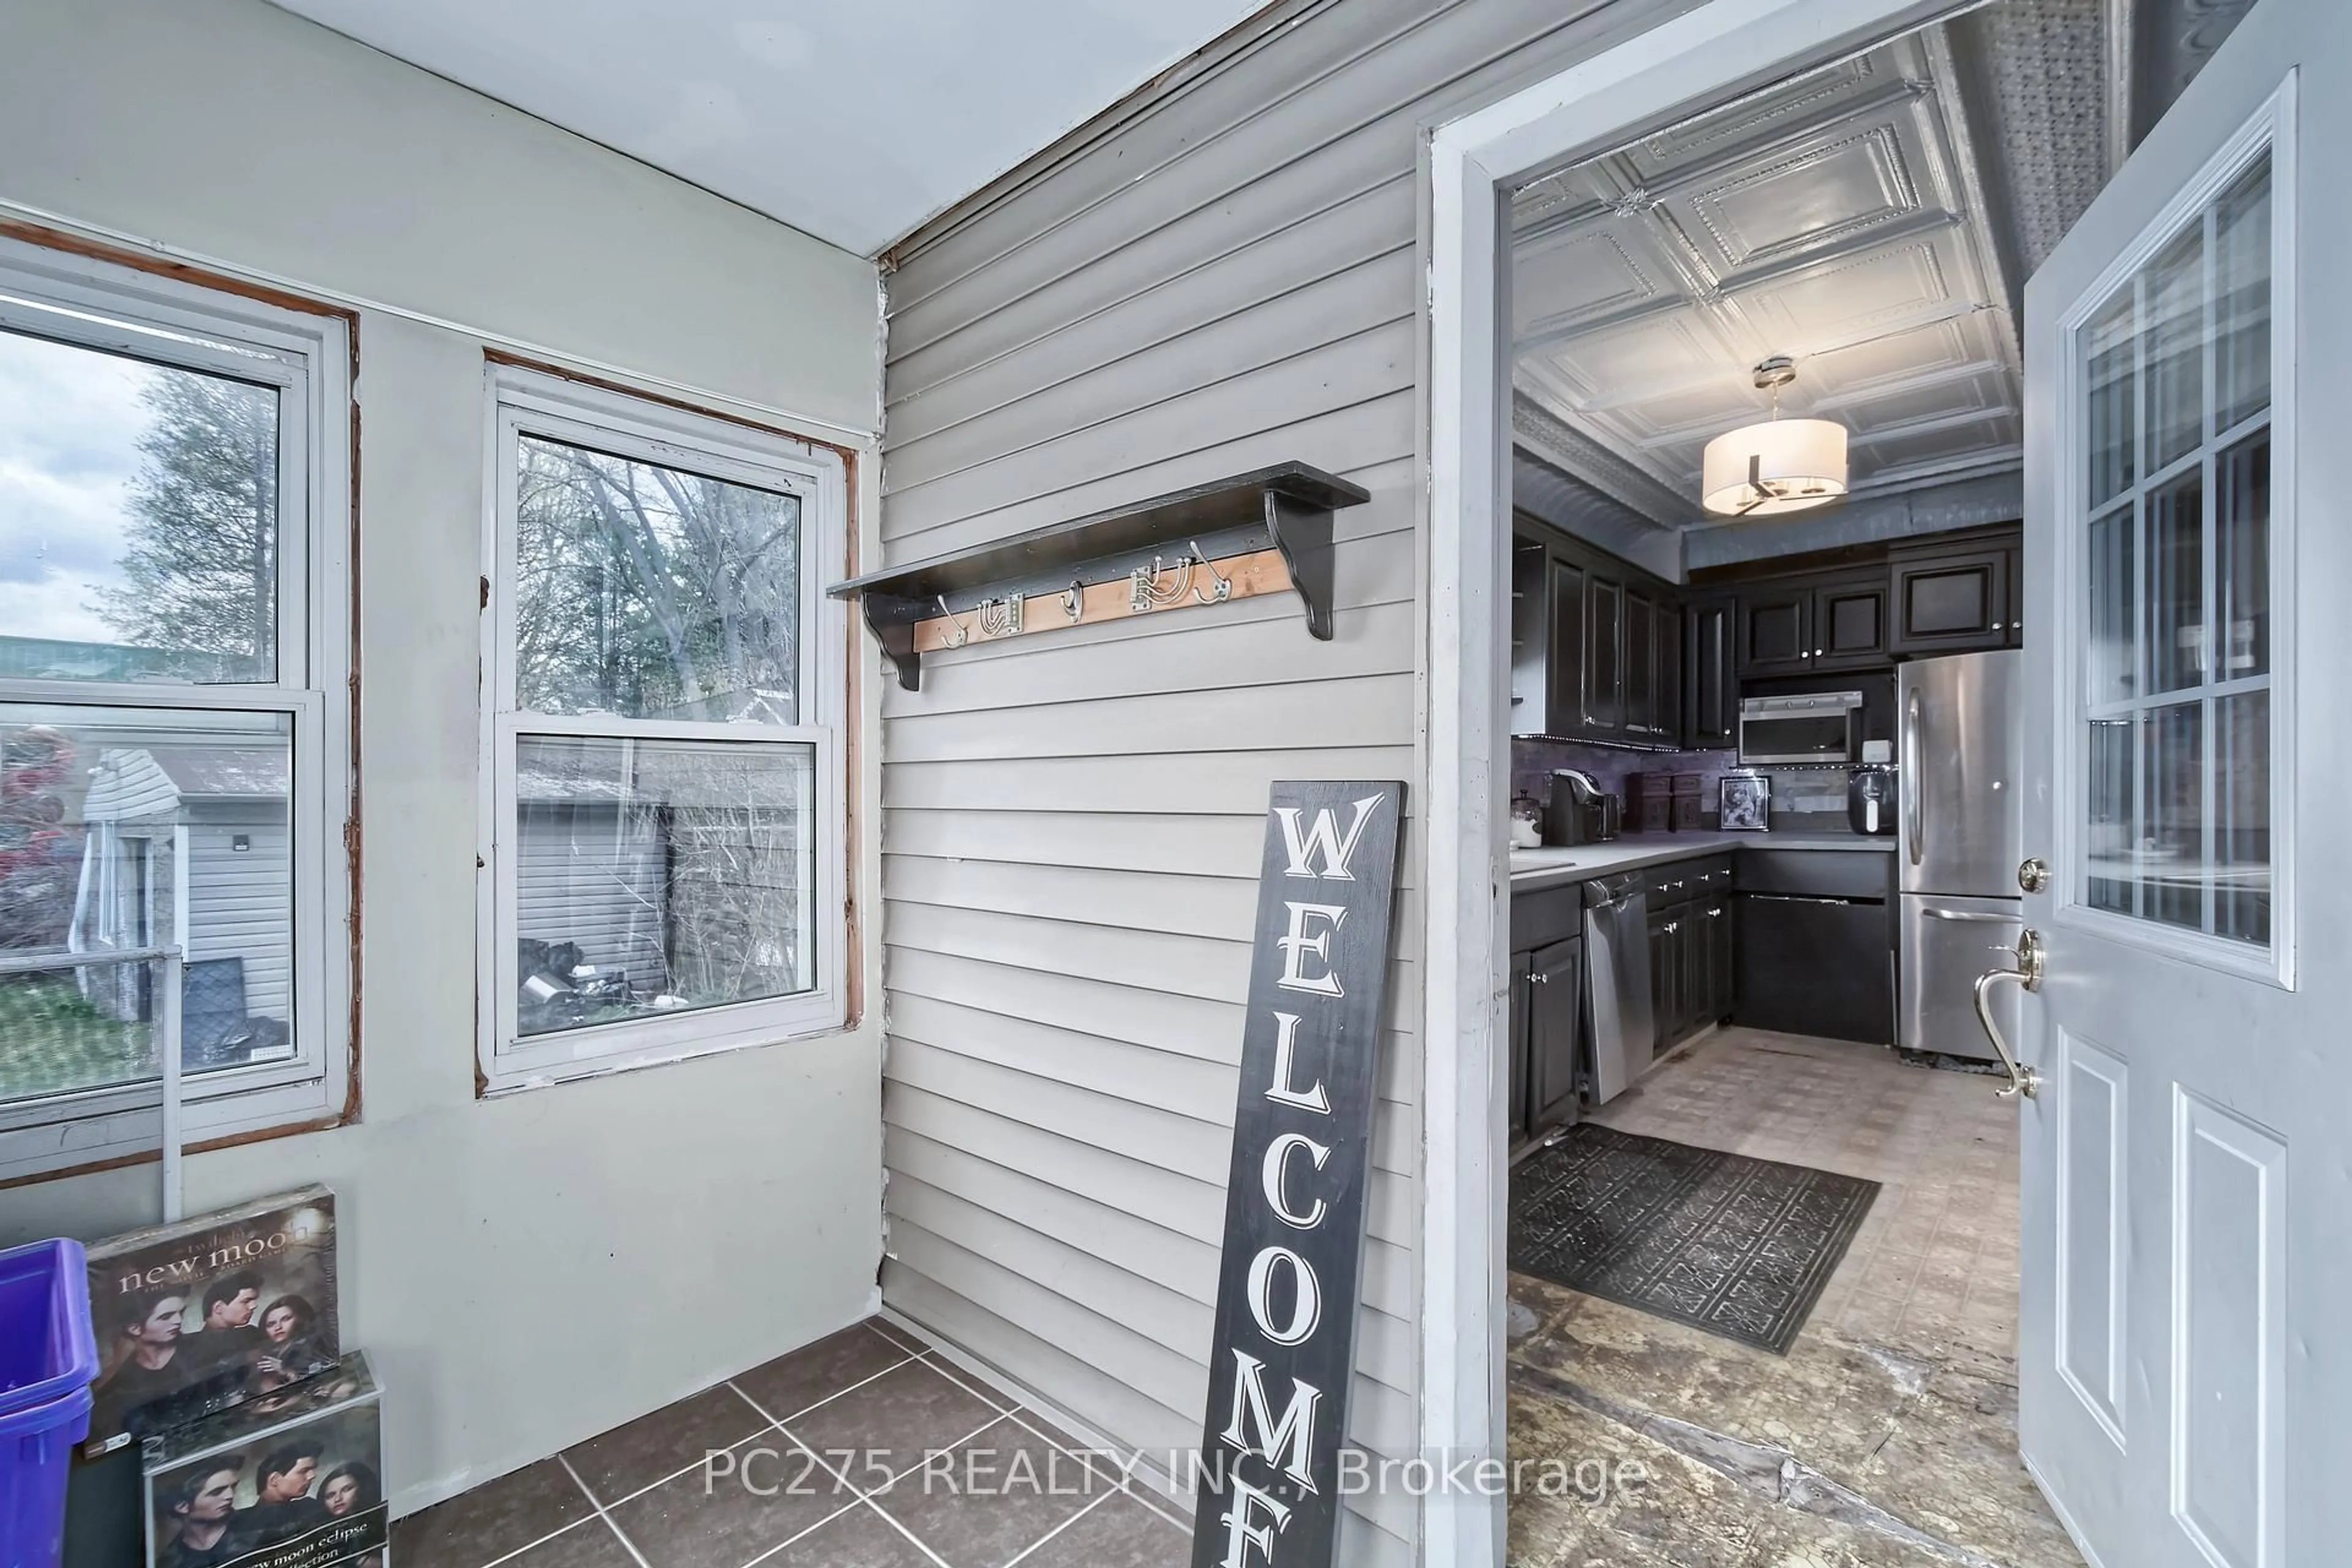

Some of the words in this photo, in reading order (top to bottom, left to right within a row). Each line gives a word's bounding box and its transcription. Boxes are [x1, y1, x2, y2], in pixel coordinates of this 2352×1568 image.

[1219, 791, 1385, 1568] WELCOME
[119, 1256, 201, 1294] new
[209, 1226, 308, 1269] moon
[273, 1543, 314, 1567] moon
[318, 1523, 368, 1546] eclipse
